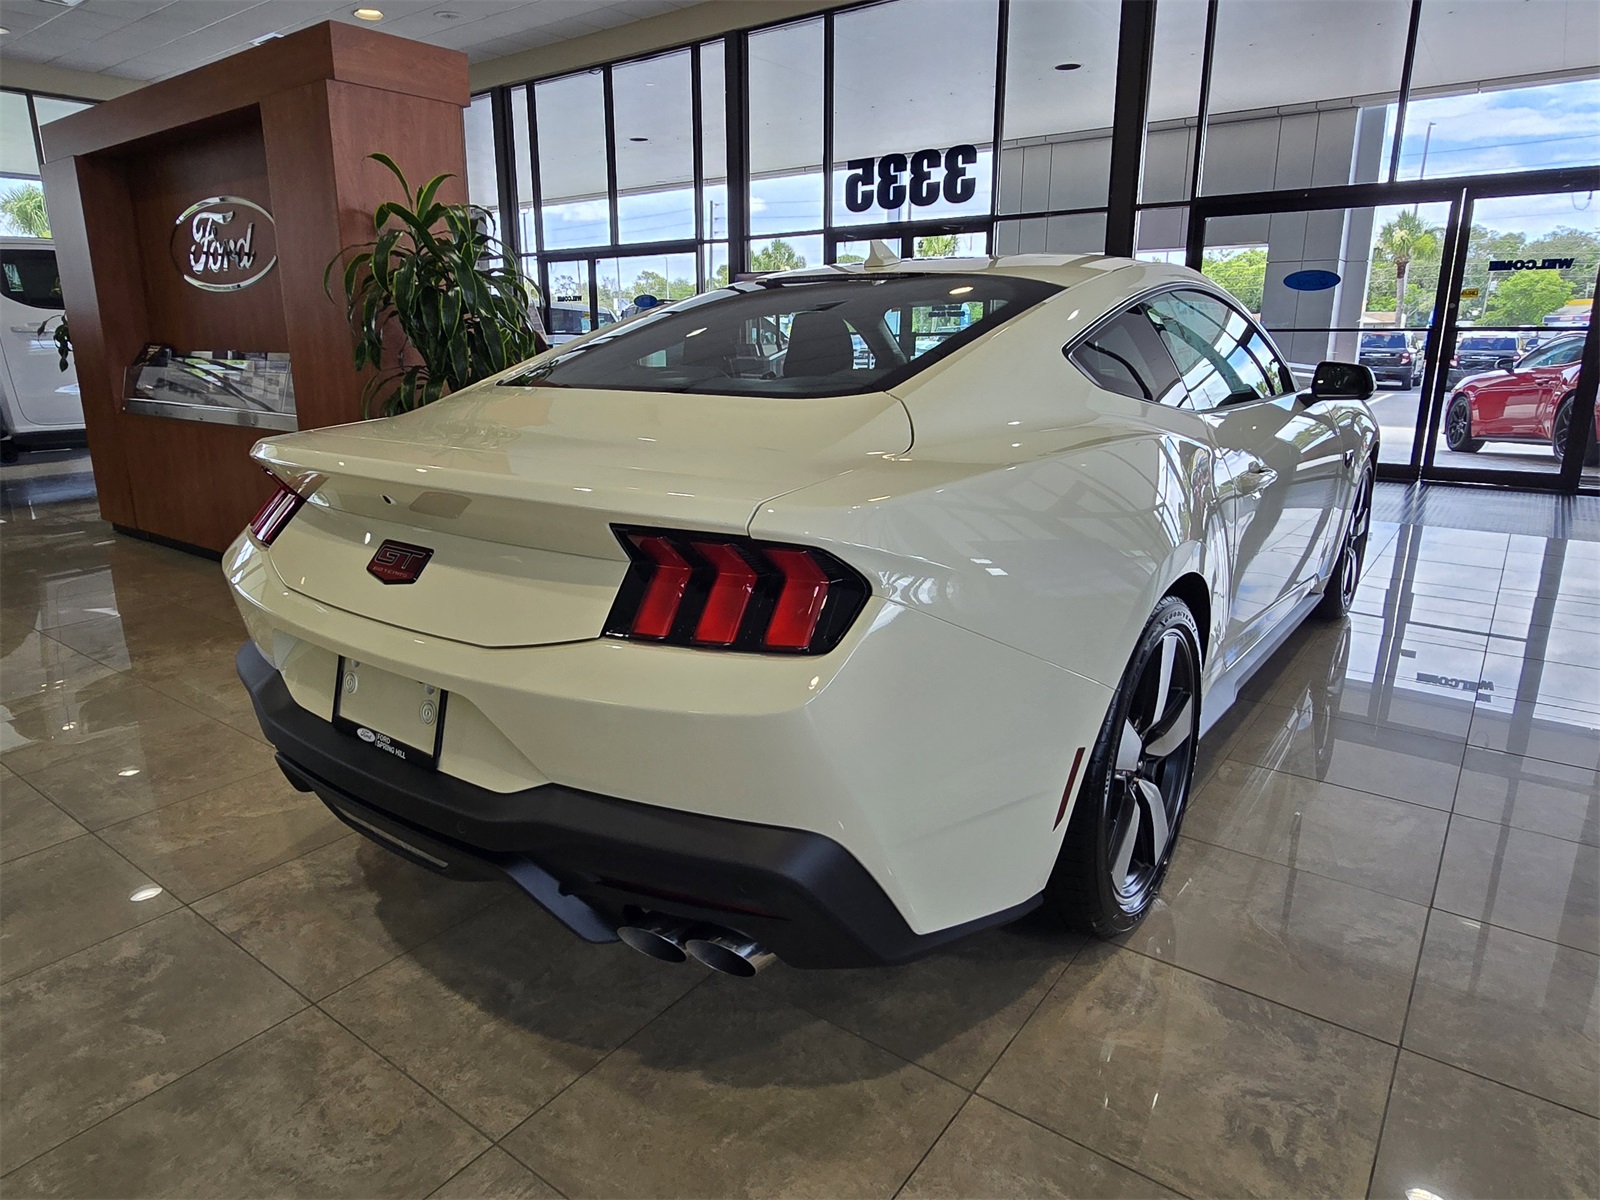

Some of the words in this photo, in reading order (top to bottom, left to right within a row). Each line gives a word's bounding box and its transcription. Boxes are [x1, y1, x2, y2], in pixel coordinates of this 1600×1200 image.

[189, 211, 255, 274] Ford
[375, 544, 426, 569] GT
[376, 740, 395, 754] SPRING
[395, 748, 406, 760] HILL
[377, 733, 391, 745] FORD
